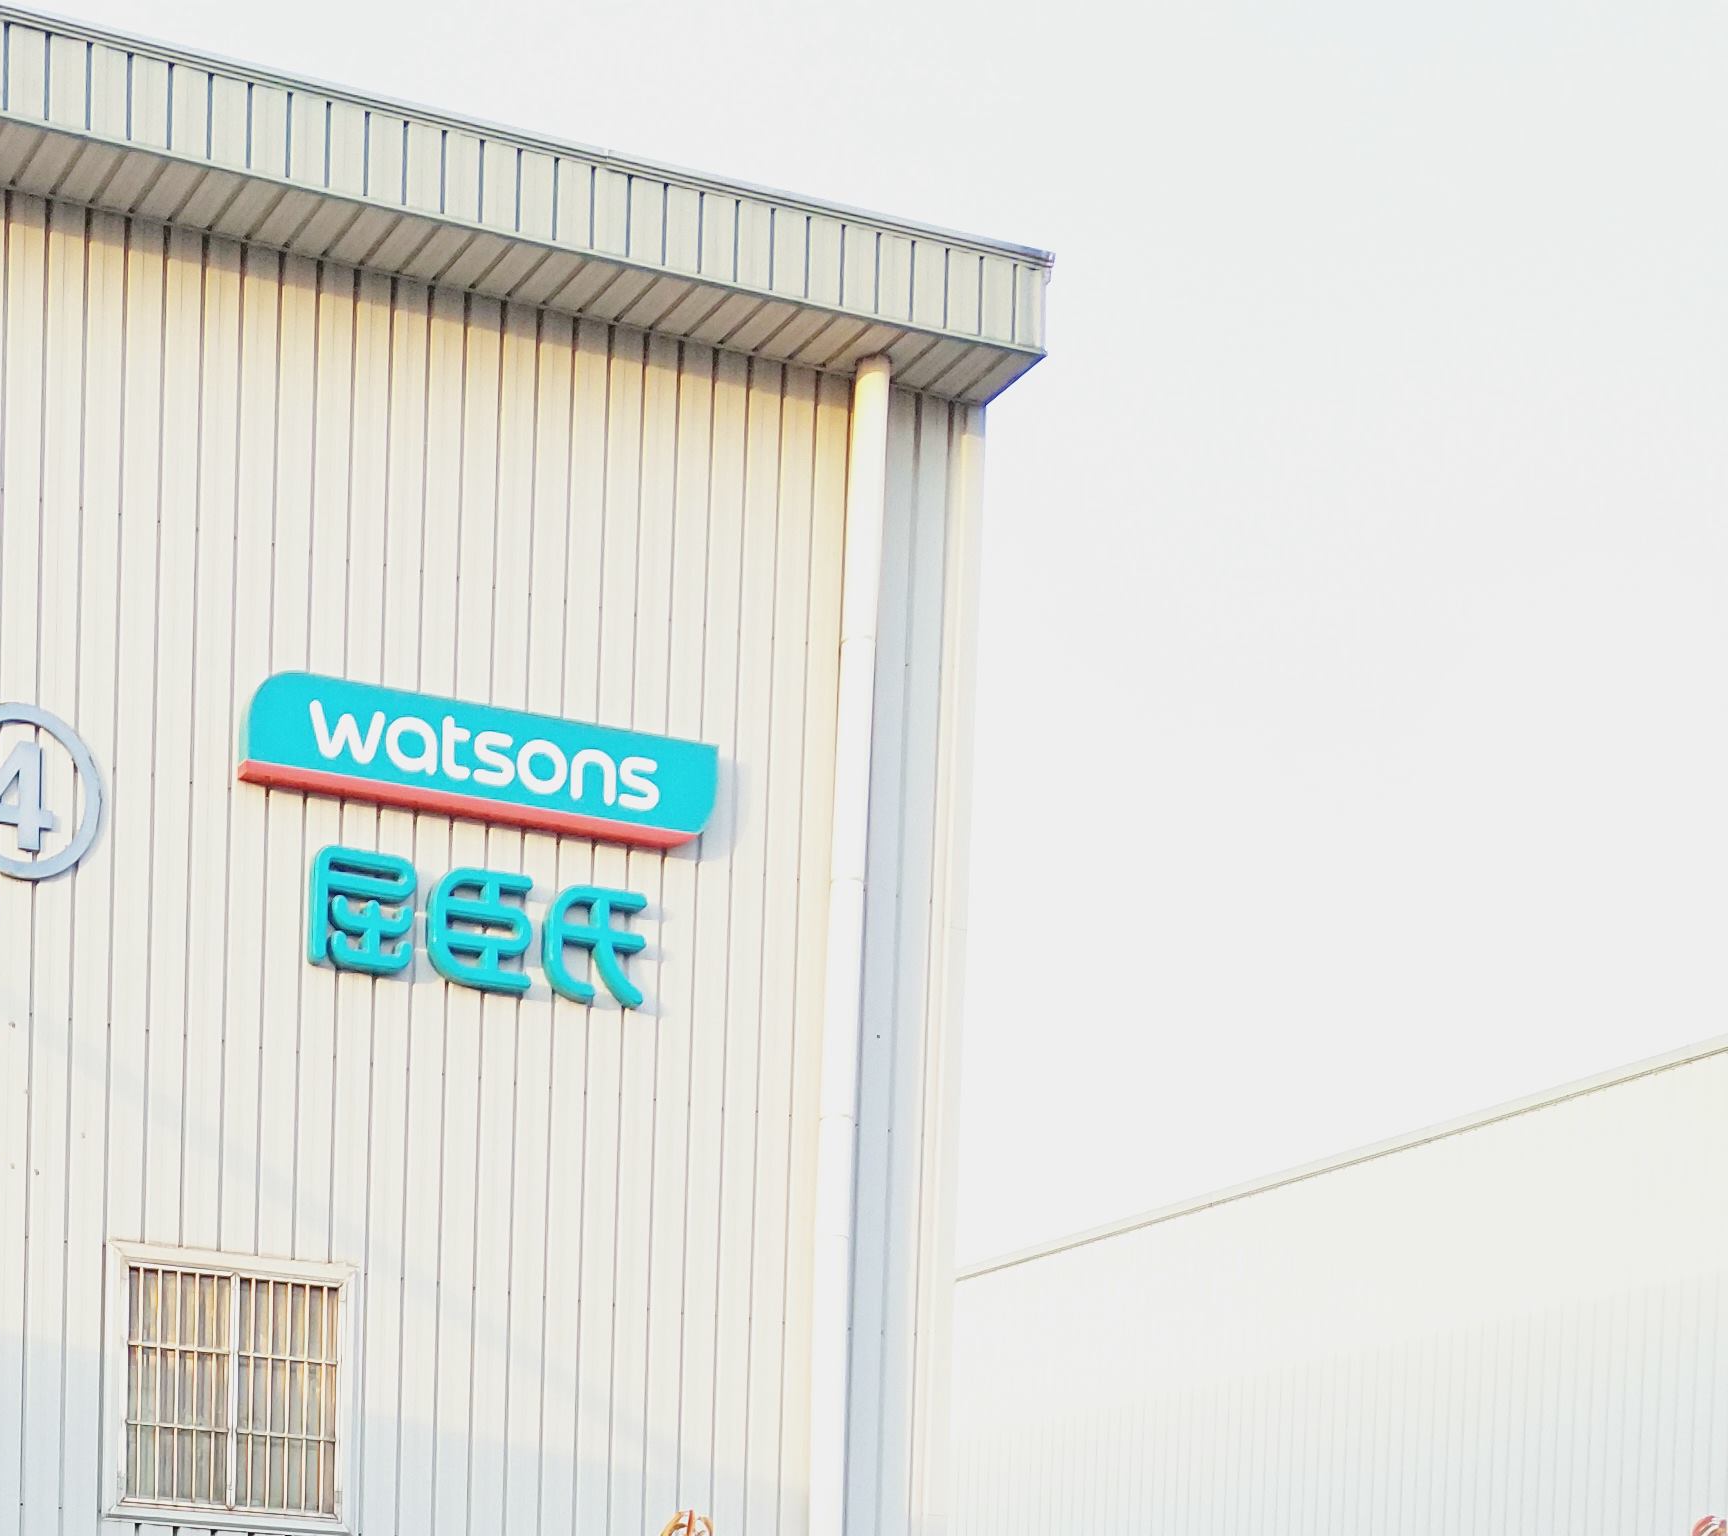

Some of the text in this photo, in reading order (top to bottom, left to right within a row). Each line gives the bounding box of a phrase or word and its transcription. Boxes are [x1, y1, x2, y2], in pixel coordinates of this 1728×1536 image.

[309, 699, 661, 813] watsons
[308, 844, 648, 1009] 屈臣氏
